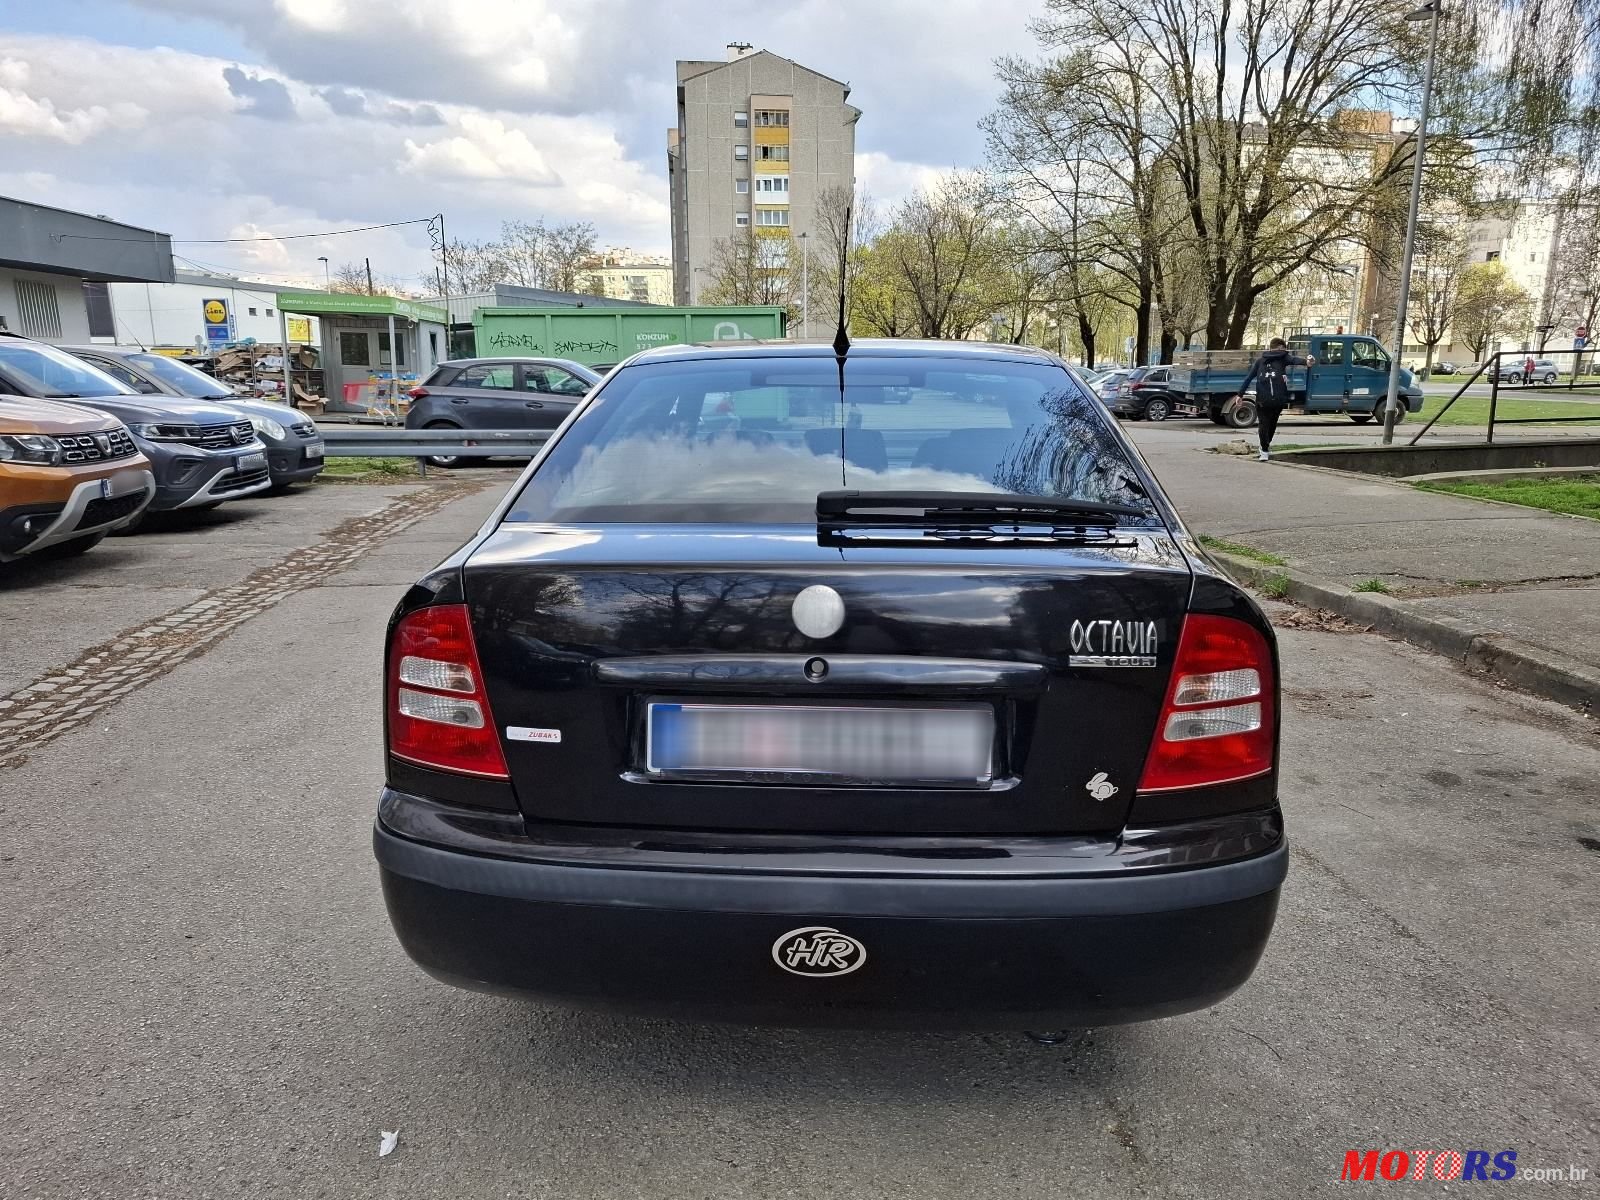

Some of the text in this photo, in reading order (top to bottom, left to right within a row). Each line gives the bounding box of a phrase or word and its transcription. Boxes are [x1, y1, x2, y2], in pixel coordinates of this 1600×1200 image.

[636, 333, 669, 341] KONZUM
[1069, 619, 1158, 654] OCTAVIA
[1108, 658, 1151, 666] TOUR
[528, 731, 552, 739] ZUBAK
[786, 937, 855, 969] HR
